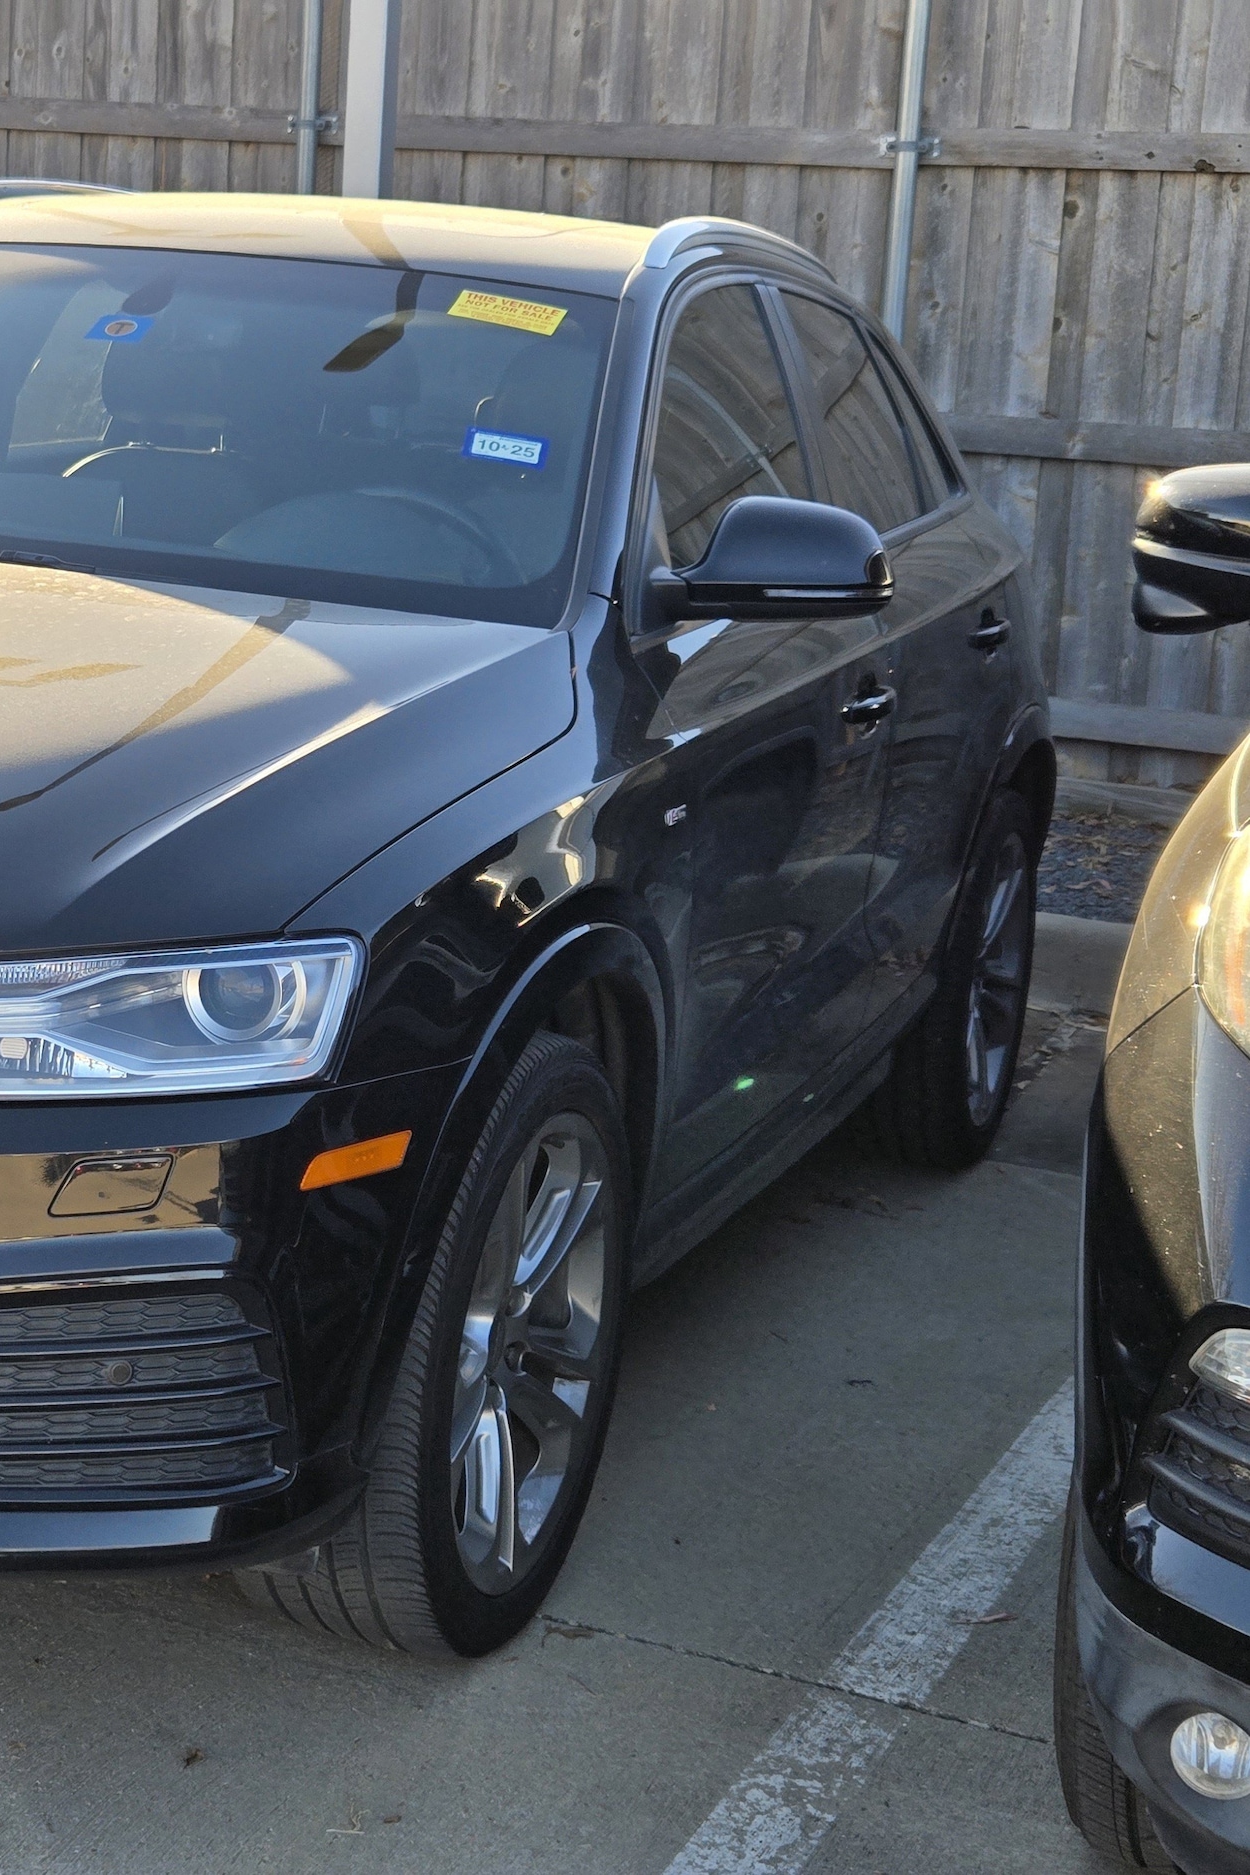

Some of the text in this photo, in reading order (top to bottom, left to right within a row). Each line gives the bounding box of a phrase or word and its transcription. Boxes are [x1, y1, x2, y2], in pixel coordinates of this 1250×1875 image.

[465, 299, 490, 308] NOT
[493, 304, 519, 313] FOR
[521, 310, 554, 321] SALE
[467, 292, 498, 303] THIS
[501, 299, 562, 316] VEHICLE
